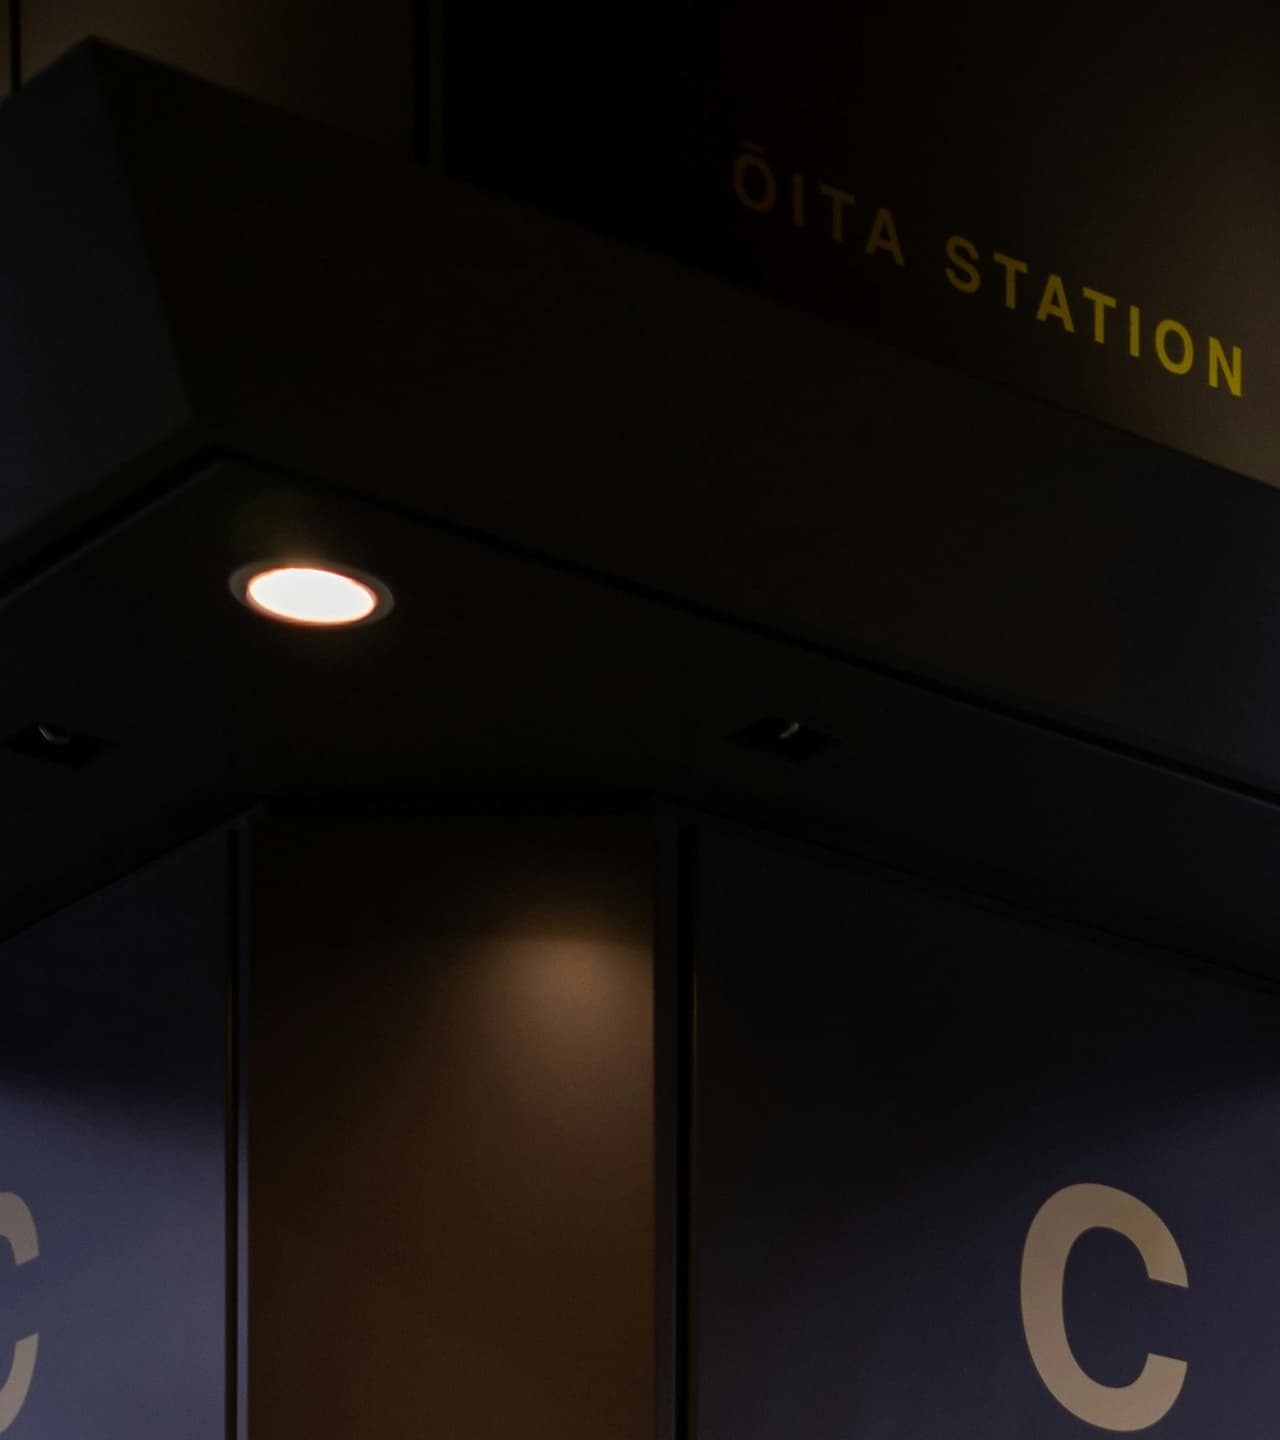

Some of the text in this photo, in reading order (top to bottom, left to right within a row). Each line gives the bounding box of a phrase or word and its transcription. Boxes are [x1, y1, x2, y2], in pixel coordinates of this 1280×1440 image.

[732, 140, 1243, 398] ŌITA STATION
[1019, 1182, 1190, 1433] C
